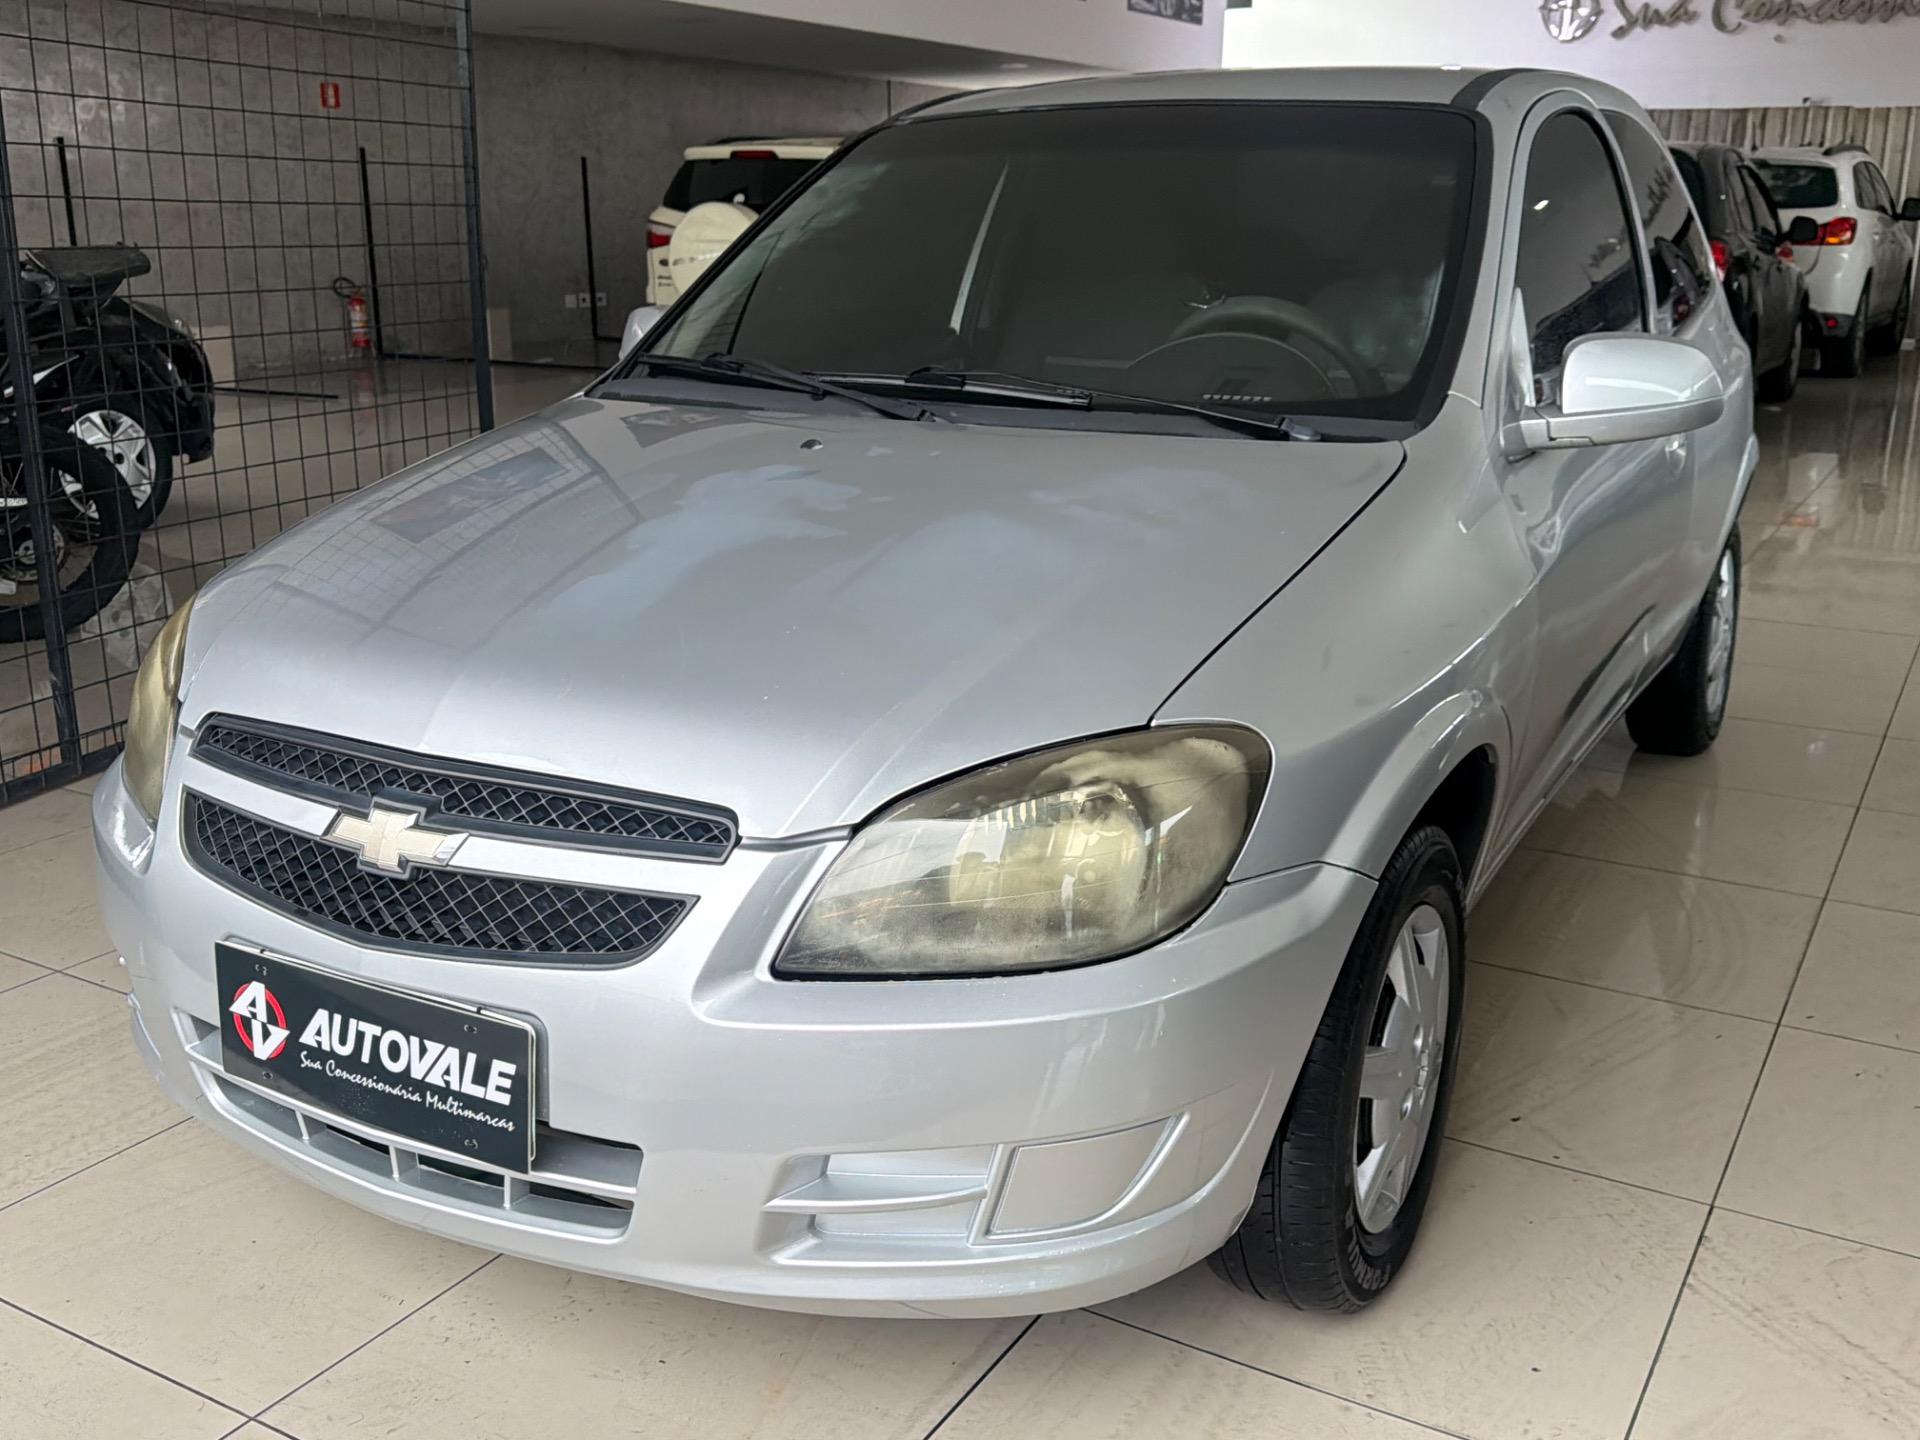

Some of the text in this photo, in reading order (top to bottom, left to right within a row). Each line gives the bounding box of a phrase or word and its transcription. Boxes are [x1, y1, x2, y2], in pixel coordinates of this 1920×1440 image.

[299, 1008, 517, 1106] AUTOVALE
[300, 1050, 515, 1132] Sua Concessionária Multimarcas
